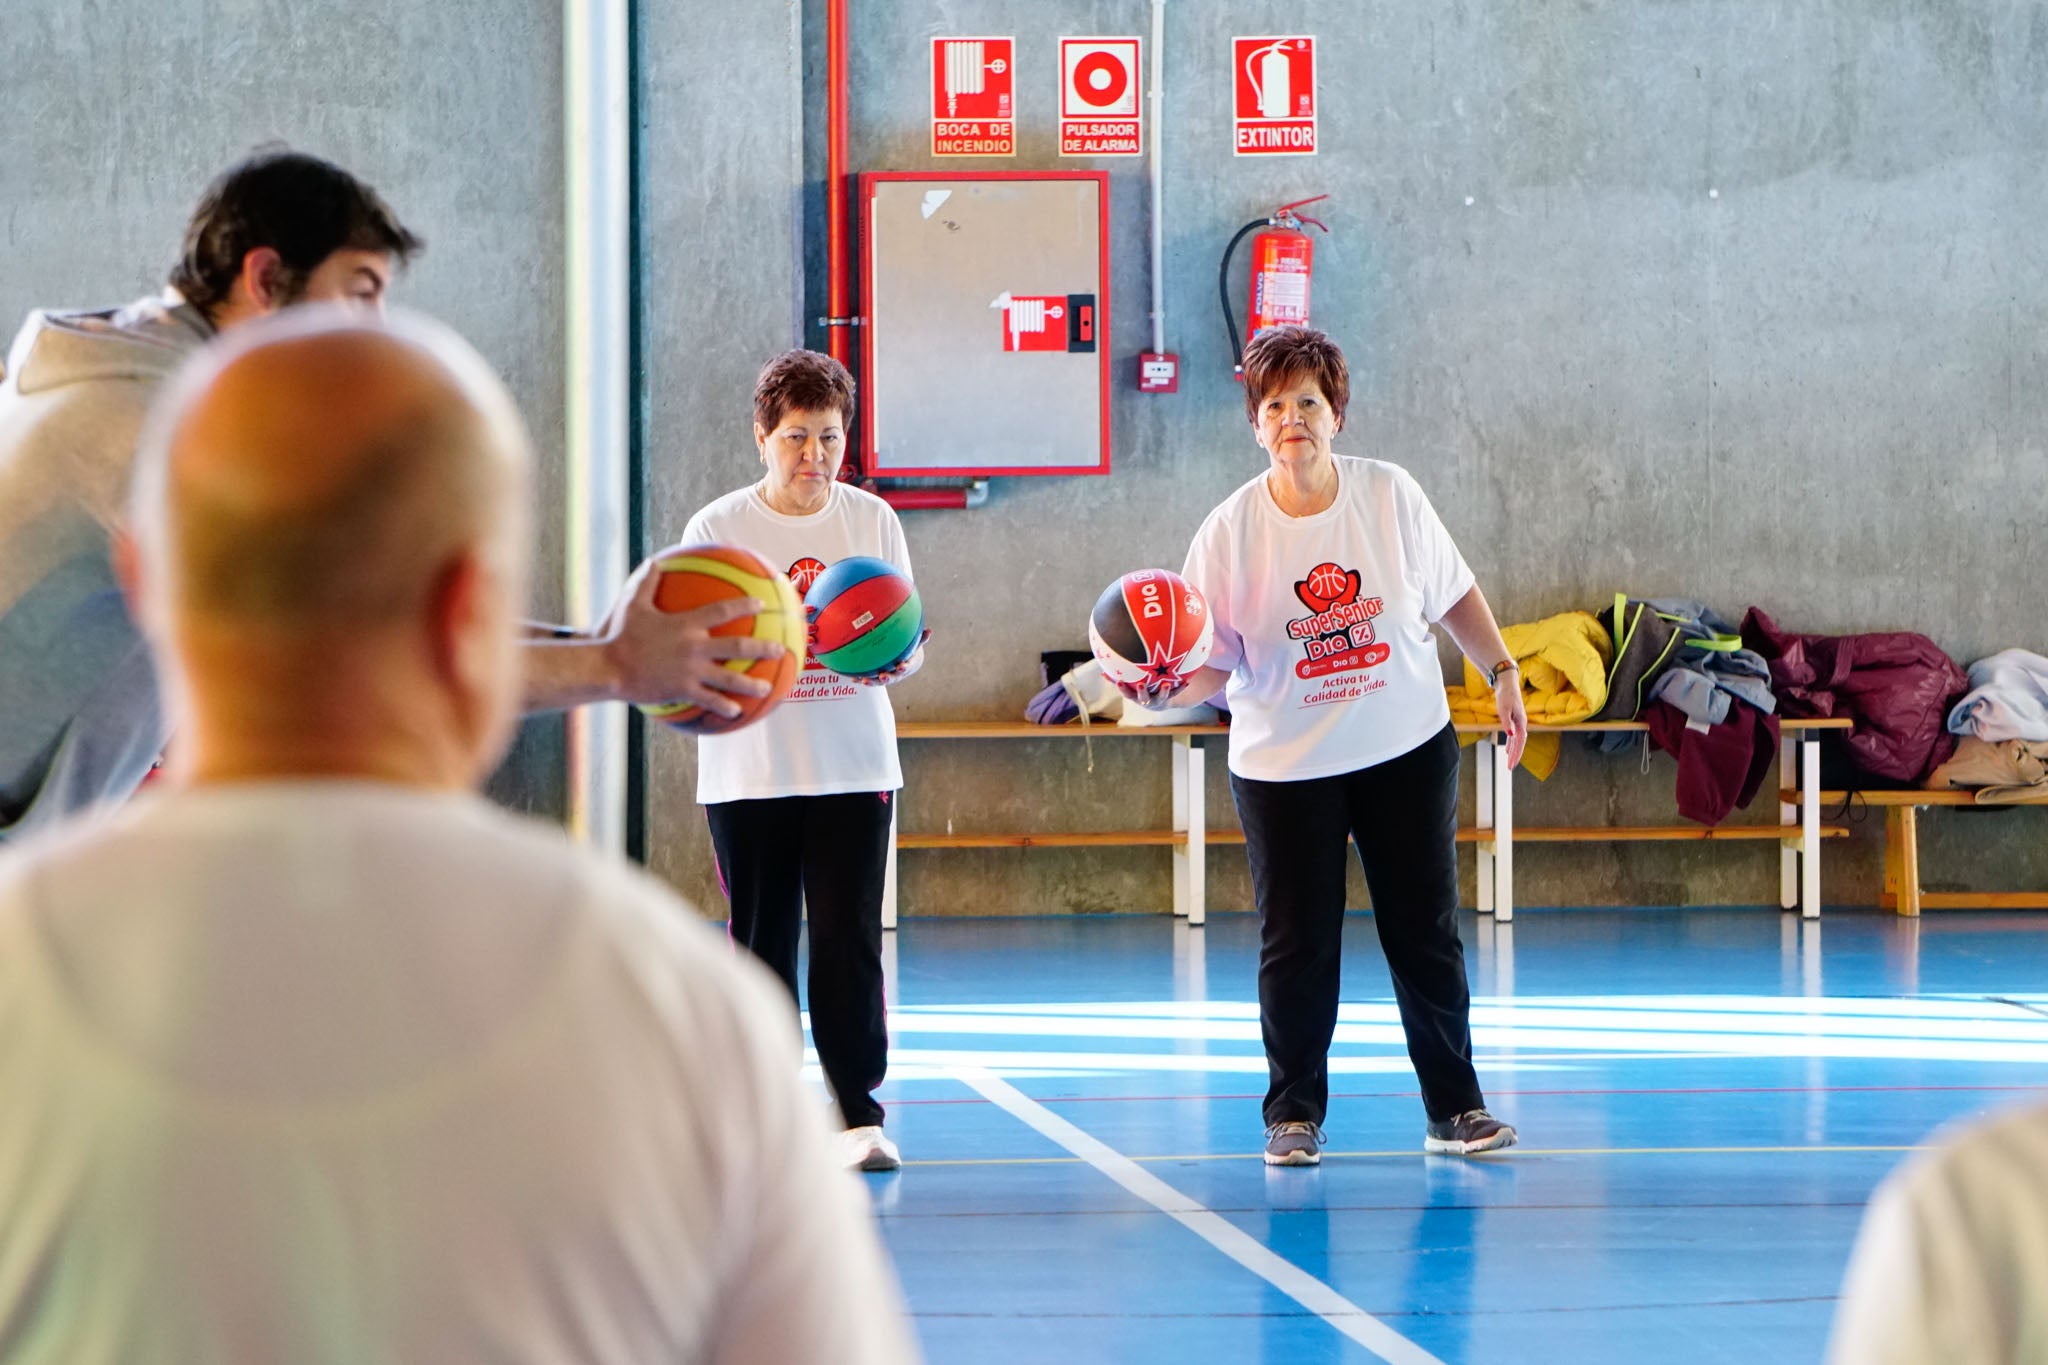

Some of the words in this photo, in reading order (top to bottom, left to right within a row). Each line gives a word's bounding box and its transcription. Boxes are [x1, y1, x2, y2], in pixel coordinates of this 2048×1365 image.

[937, 124, 981, 136] BOCA
[989, 124, 1010, 136] DE
[1066, 124, 1136, 136] PULSADOR
[1238, 126, 1313, 148] EXTINTOR
[937, 140, 1011, 152] INCENDIO
[1064, 140, 1082, 151] DE
[1084, 140, 1138, 151] ALARMA
[796, 675, 826, 685] ctiva
[828, 674, 839, 684] tu
[1322, 676, 1356, 689] Activa
[1359, 674, 1370, 683] tu
[817, 686, 829, 697] de
[832, 685, 857, 695] Vida.
[1304, 687, 1346, 704] Calidad
[1348, 686, 1361, 696] de
[1363, 679, 1388, 693] Vida.
